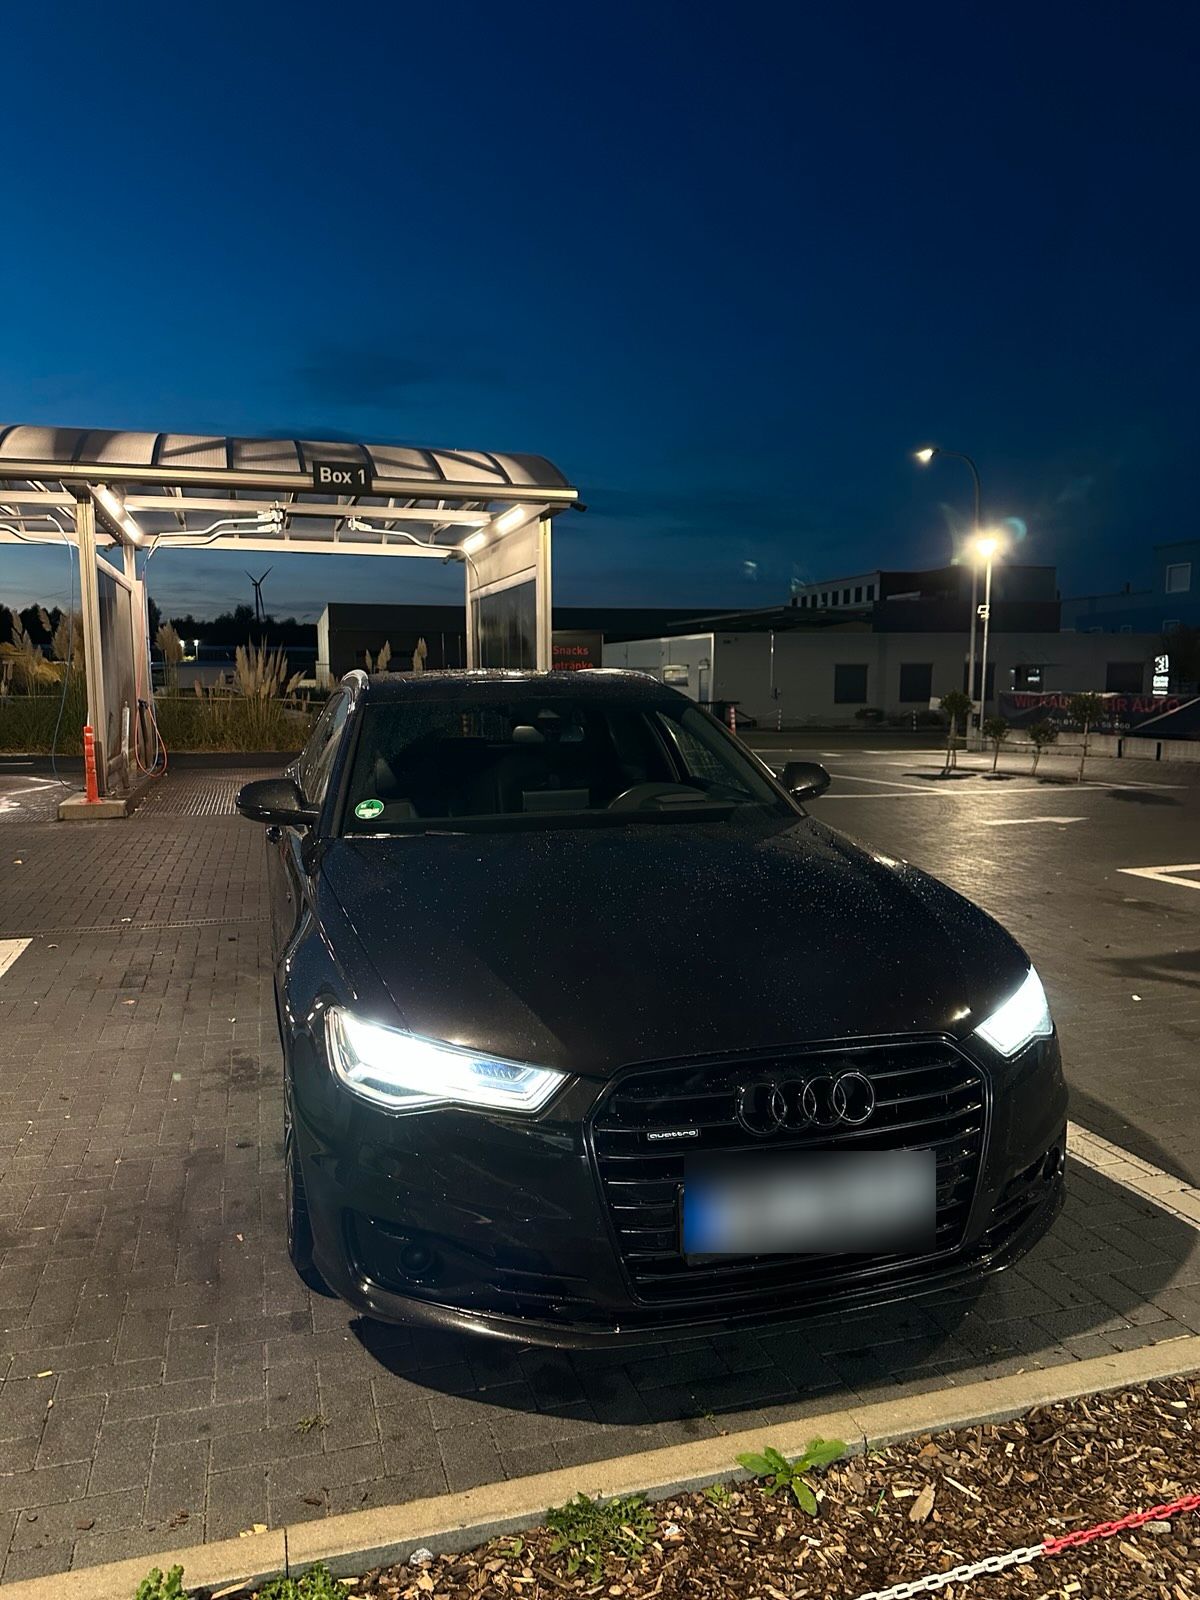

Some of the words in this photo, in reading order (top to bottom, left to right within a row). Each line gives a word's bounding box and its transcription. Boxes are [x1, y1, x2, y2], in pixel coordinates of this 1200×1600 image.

[320, 466, 353, 484] Box
[358, 469, 365, 484] 1
[553, 645, 589, 655] Snacks
[650, 1130, 695, 1138] quattro
